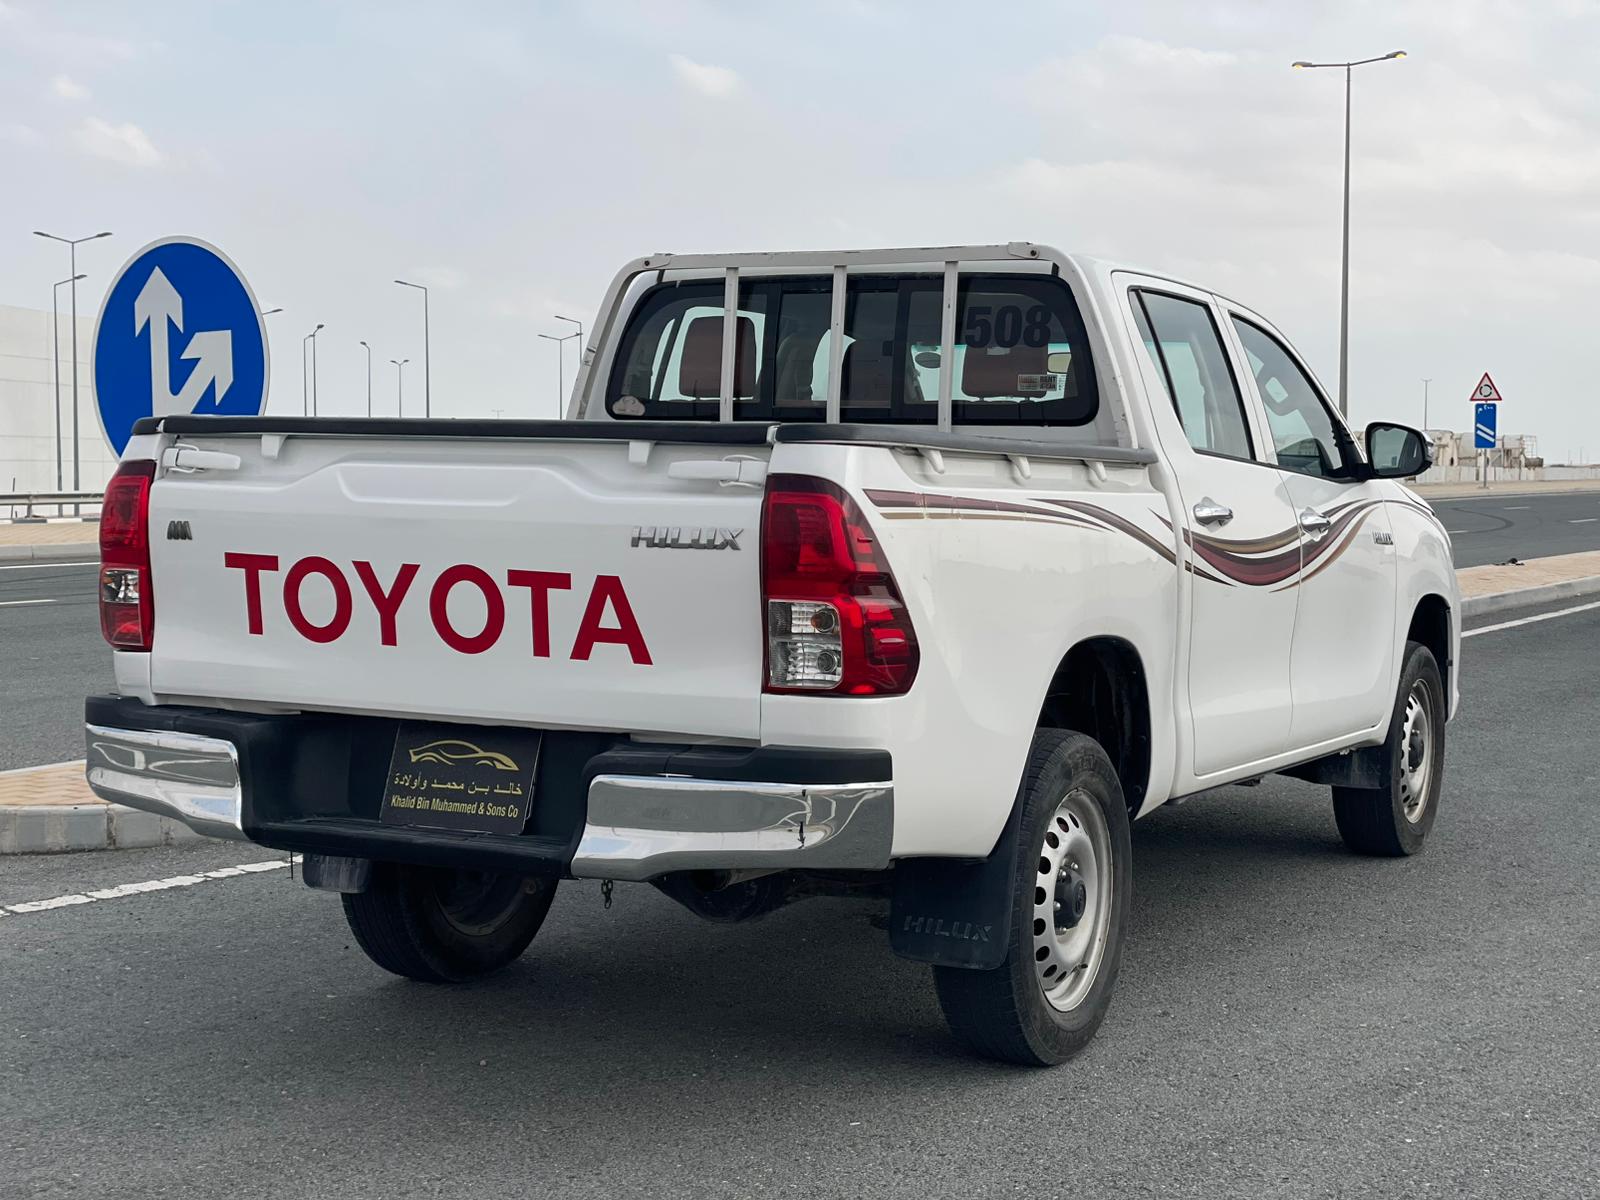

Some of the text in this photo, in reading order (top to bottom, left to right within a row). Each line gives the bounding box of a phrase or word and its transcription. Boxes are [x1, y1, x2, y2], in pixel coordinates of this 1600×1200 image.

[965, 305, 1051, 348] 508
[631, 526, 744, 551] HILUX
[224, 552, 653, 665] TOYOTA
[431, 779, 464, 790] محمد
[467, 781, 490, 796] بن
[493, 781, 522, 795] خالد
[391, 795, 519, 818] Khalid Bin Muhammed & Sons Co
[903, 915, 993, 942] HILUX
